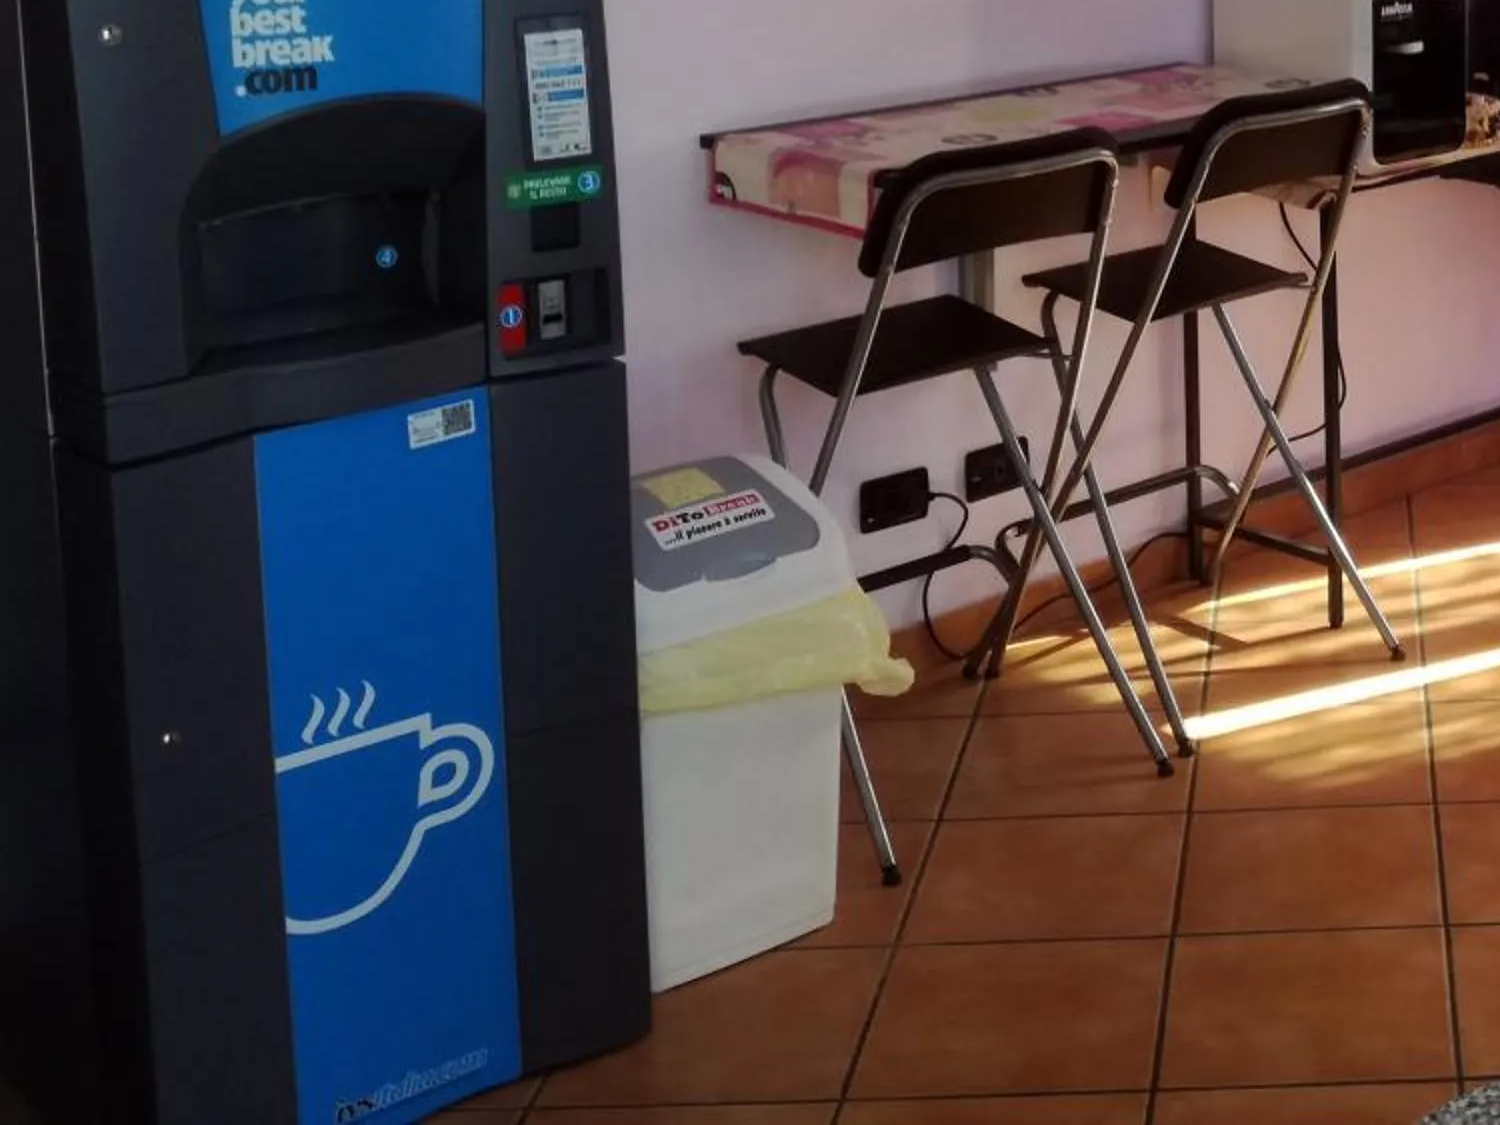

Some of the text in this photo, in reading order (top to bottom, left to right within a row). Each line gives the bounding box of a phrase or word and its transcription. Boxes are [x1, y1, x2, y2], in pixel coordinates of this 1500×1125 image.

[230, 5, 307, 37] best
[232, 35, 335, 68] break
[235, 67, 318, 96] .com
